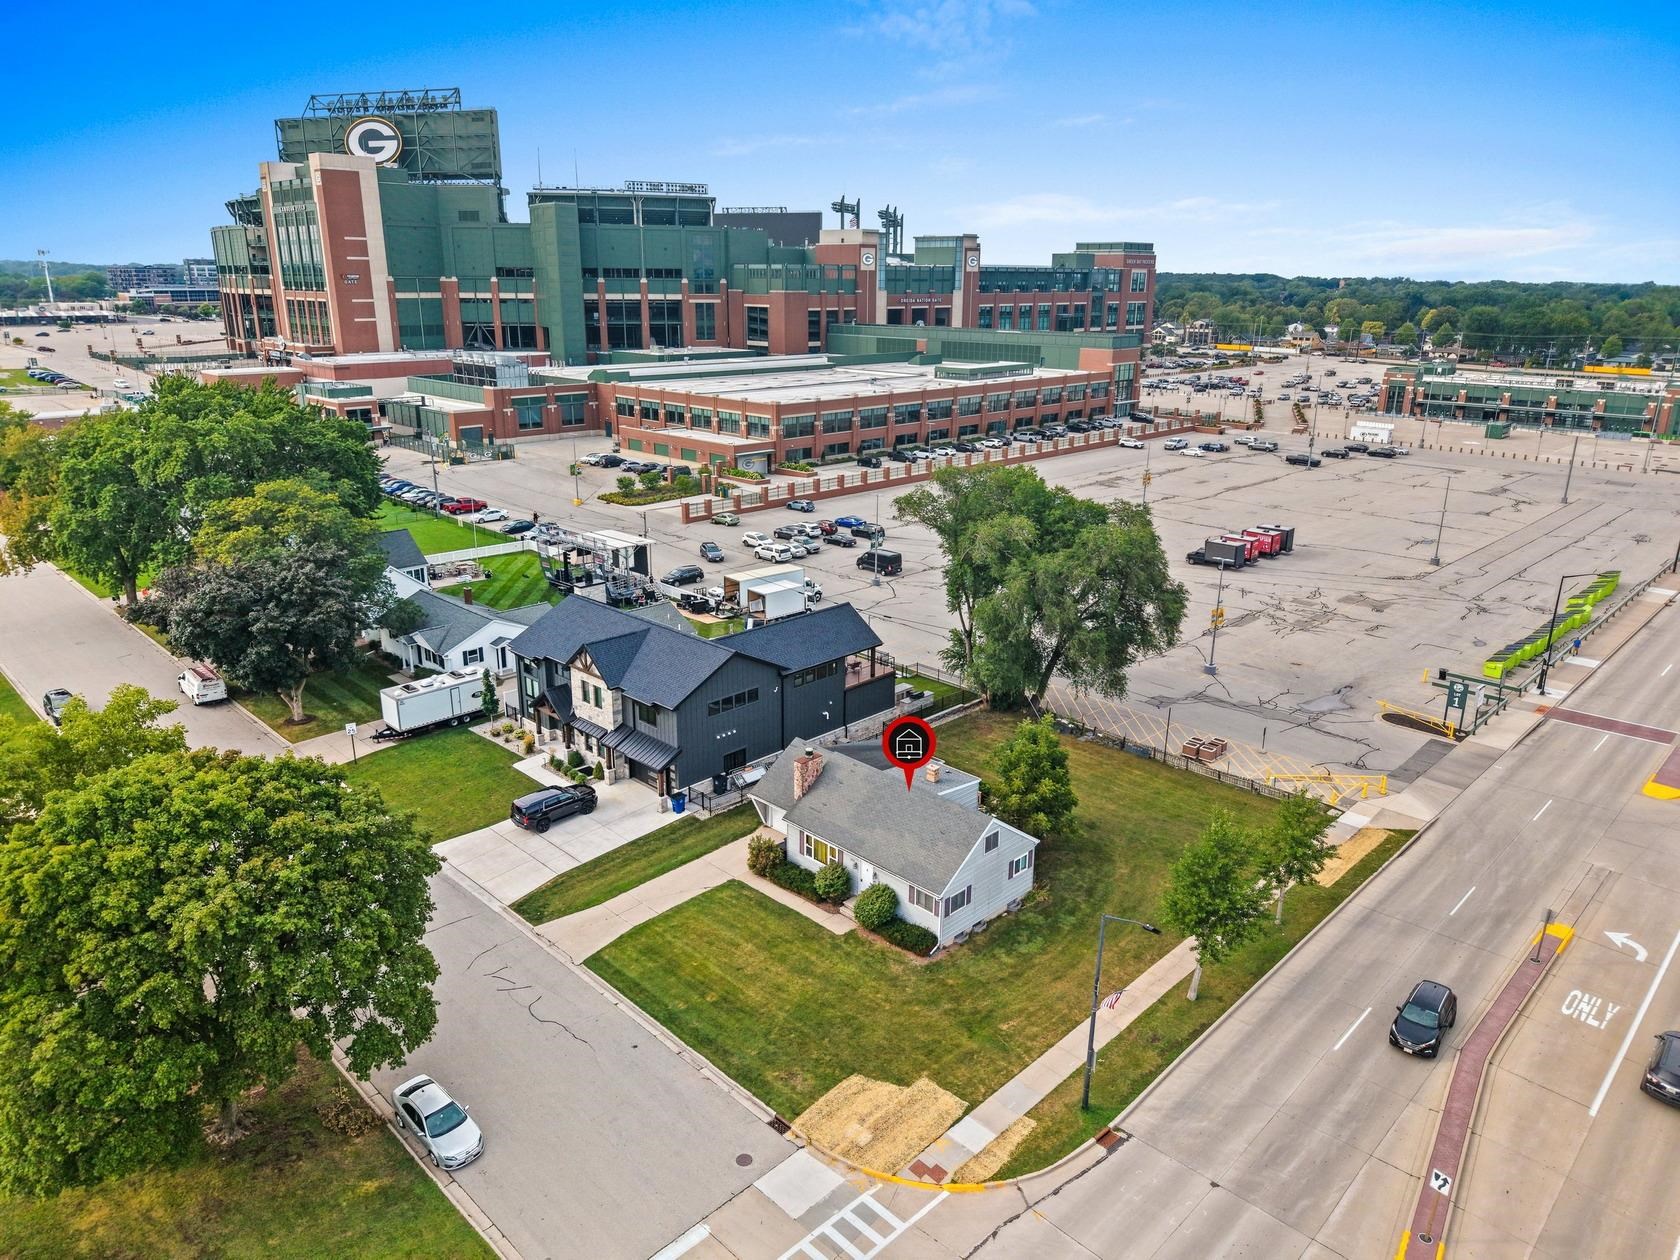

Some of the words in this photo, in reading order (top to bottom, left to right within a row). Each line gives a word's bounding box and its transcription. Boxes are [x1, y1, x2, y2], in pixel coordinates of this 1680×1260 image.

[348, 121, 398, 163] G
[862, 253, 874, 265] G
[968, 256, 978, 266] G
[743, 459, 754, 469] G
[1453, 697, 1460, 707] 1
[1561, 990, 1621, 1029] ONLY
